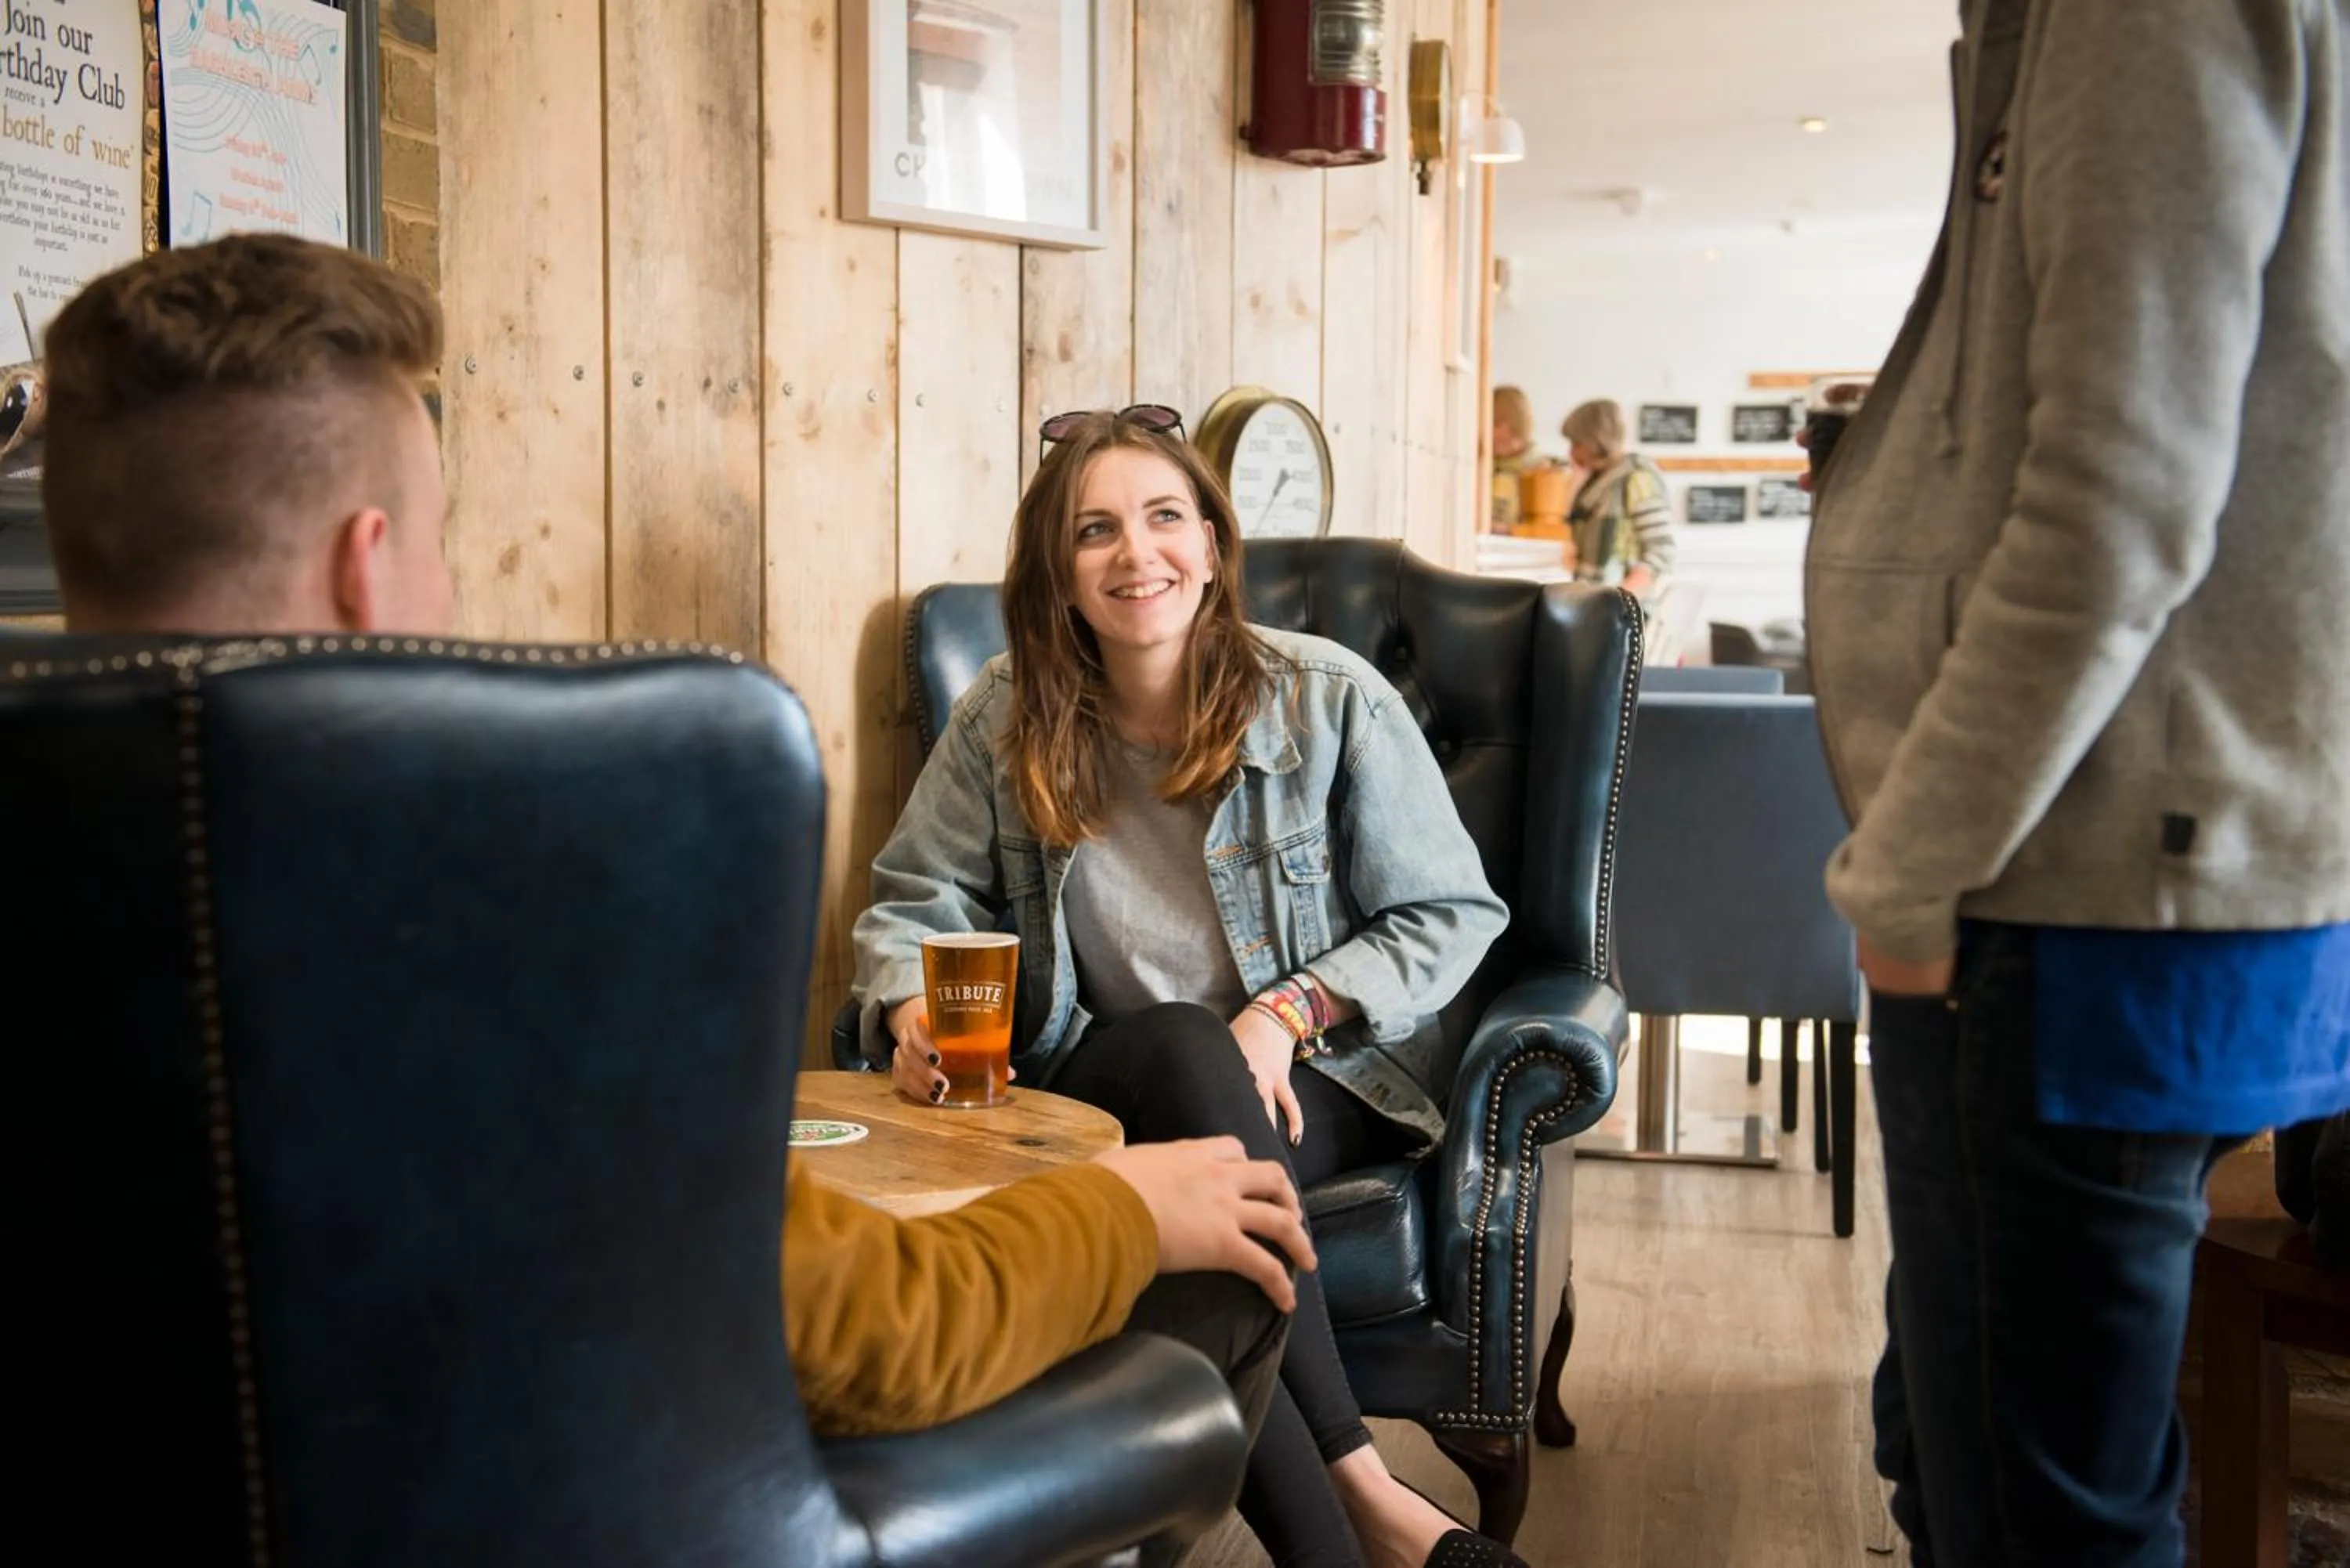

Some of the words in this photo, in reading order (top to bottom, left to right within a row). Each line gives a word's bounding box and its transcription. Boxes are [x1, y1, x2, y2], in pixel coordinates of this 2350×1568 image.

[5, 0, 46, 41] Join
[57, 24, 93, 55] our
[5, 87, 37, 105] receive
[78, 63, 125, 110] Club
[2, 105, 55, 150] bottle
[63, 125, 85, 157] of
[936, 985, 1002, 1003] TRIBUTE
